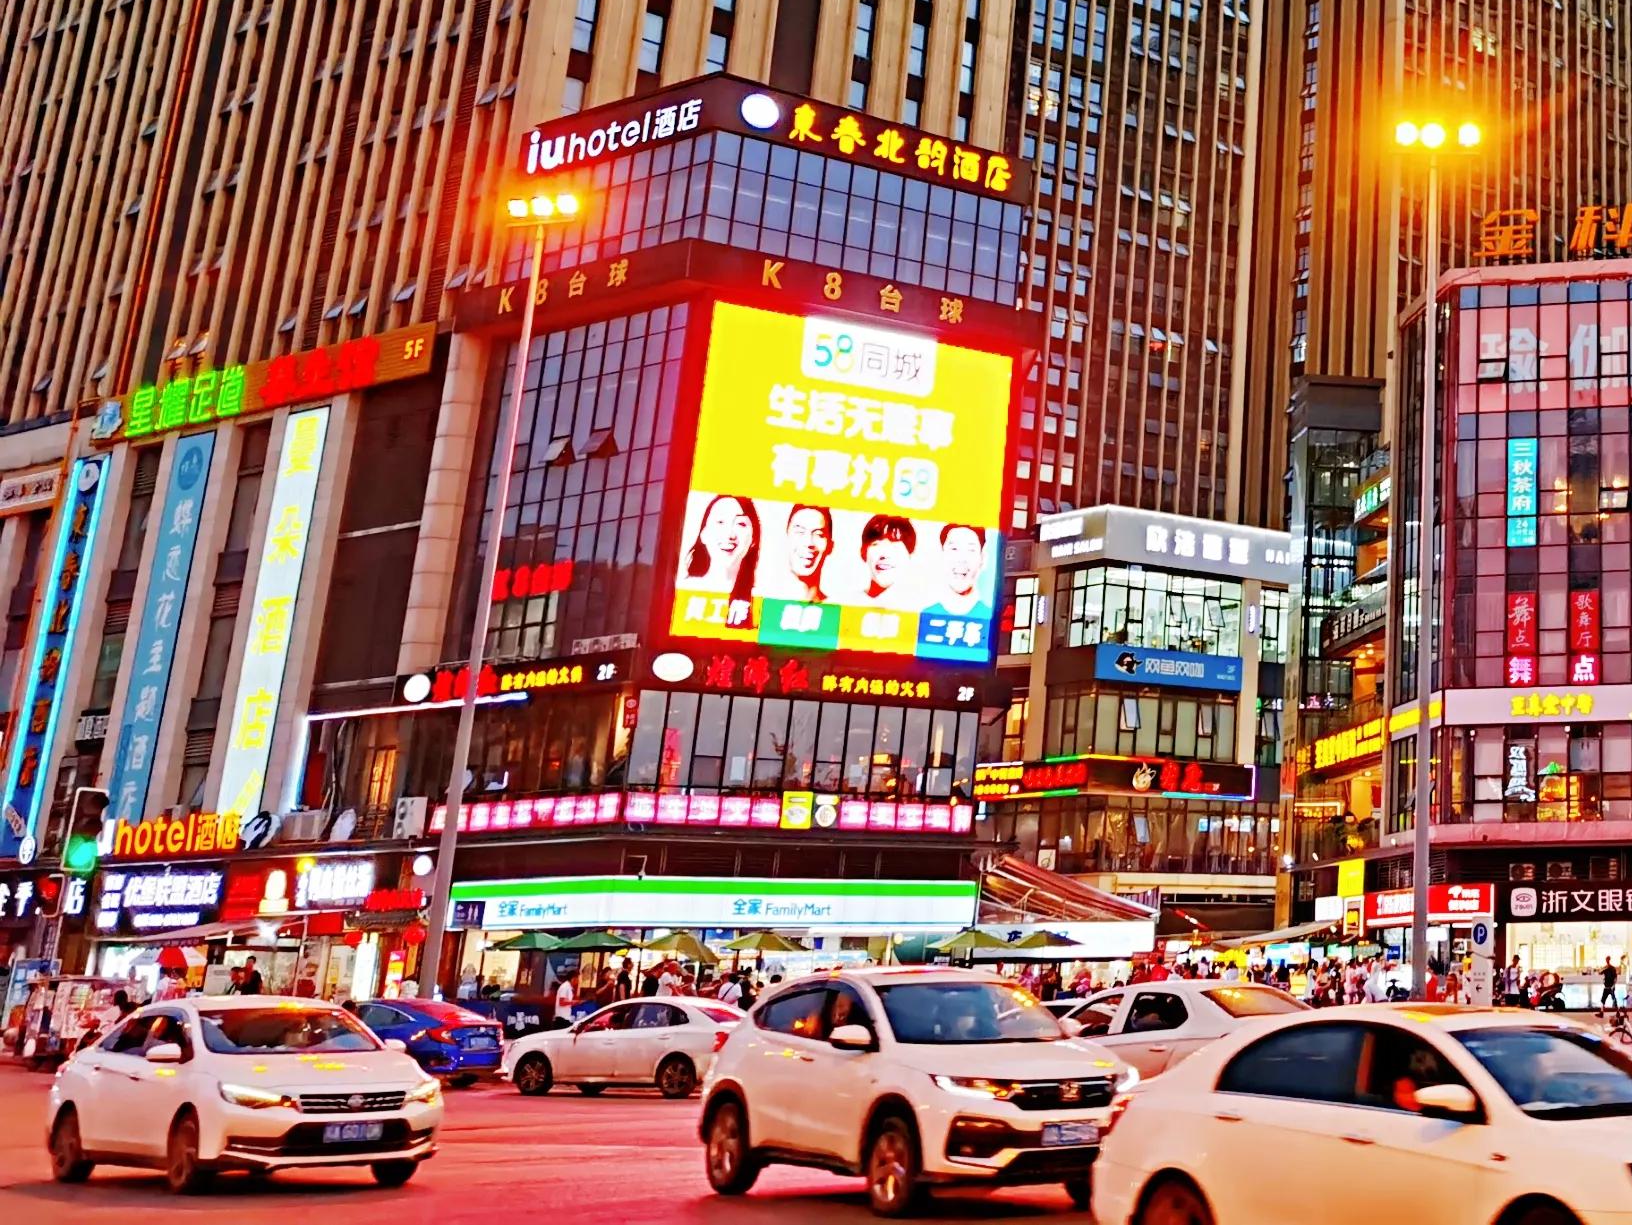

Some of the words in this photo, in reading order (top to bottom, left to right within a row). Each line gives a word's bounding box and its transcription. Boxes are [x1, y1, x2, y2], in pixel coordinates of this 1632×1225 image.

[1512, 442, 1532, 511] 三秋茶府
[1574, 594, 1594, 648] 歌舞厅
[732, 898, 762, 915] 全家
[765, 902, 832, 920] FamilyMart
